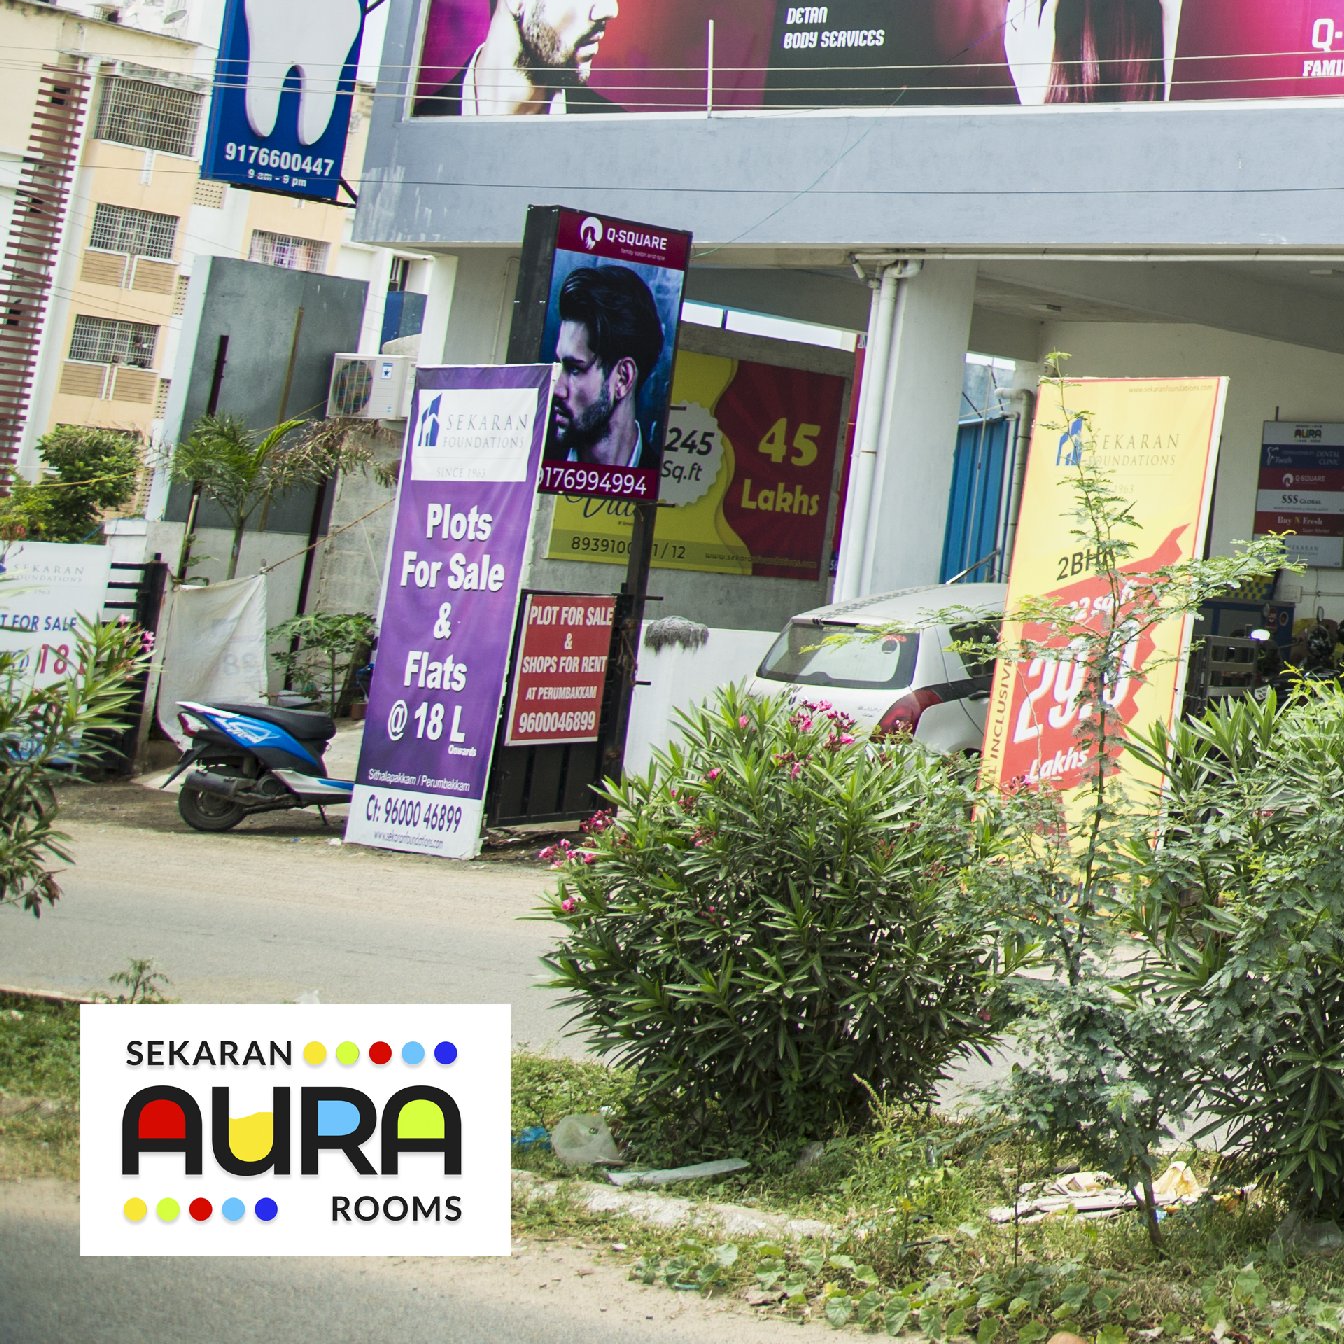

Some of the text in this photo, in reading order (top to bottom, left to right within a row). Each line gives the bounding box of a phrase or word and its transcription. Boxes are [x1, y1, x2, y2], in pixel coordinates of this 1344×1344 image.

[786, 7, 828, 25] DETAN
[783, 30, 885, 49] BODY SERVICES
[225, 142, 335, 176] 9176600447
[446, 413, 529, 432] SEKARAN
[1294, 428, 1323, 440] AURA
[443, 435, 524, 449] FOUNDATIONS
[757, 416, 822, 468] 45
[660, 459, 703, 484] Sq.ft
[740, 478, 821, 517] Lakhs
[427, 503, 493, 543] Plots
[401, 552, 504, 593] For Sale
[12, 614, 40, 631] FOR
[432, 601, 453, 641] &
[529, 606, 614, 626] PLOT FOR SALE
[564, 632, 573, 650] &
[403, 650, 468, 693] Flats
[522, 655, 608, 673] SHOPS FOR RENT
[525, 687, 537, 701] AT
[388, 701, 465, 743] @ 18 L
[518, 711, 597, 734] 9600046899
[1027, 745, 1090, 784] Lakhs
[384, 797, 462, 833] 96000 46899
